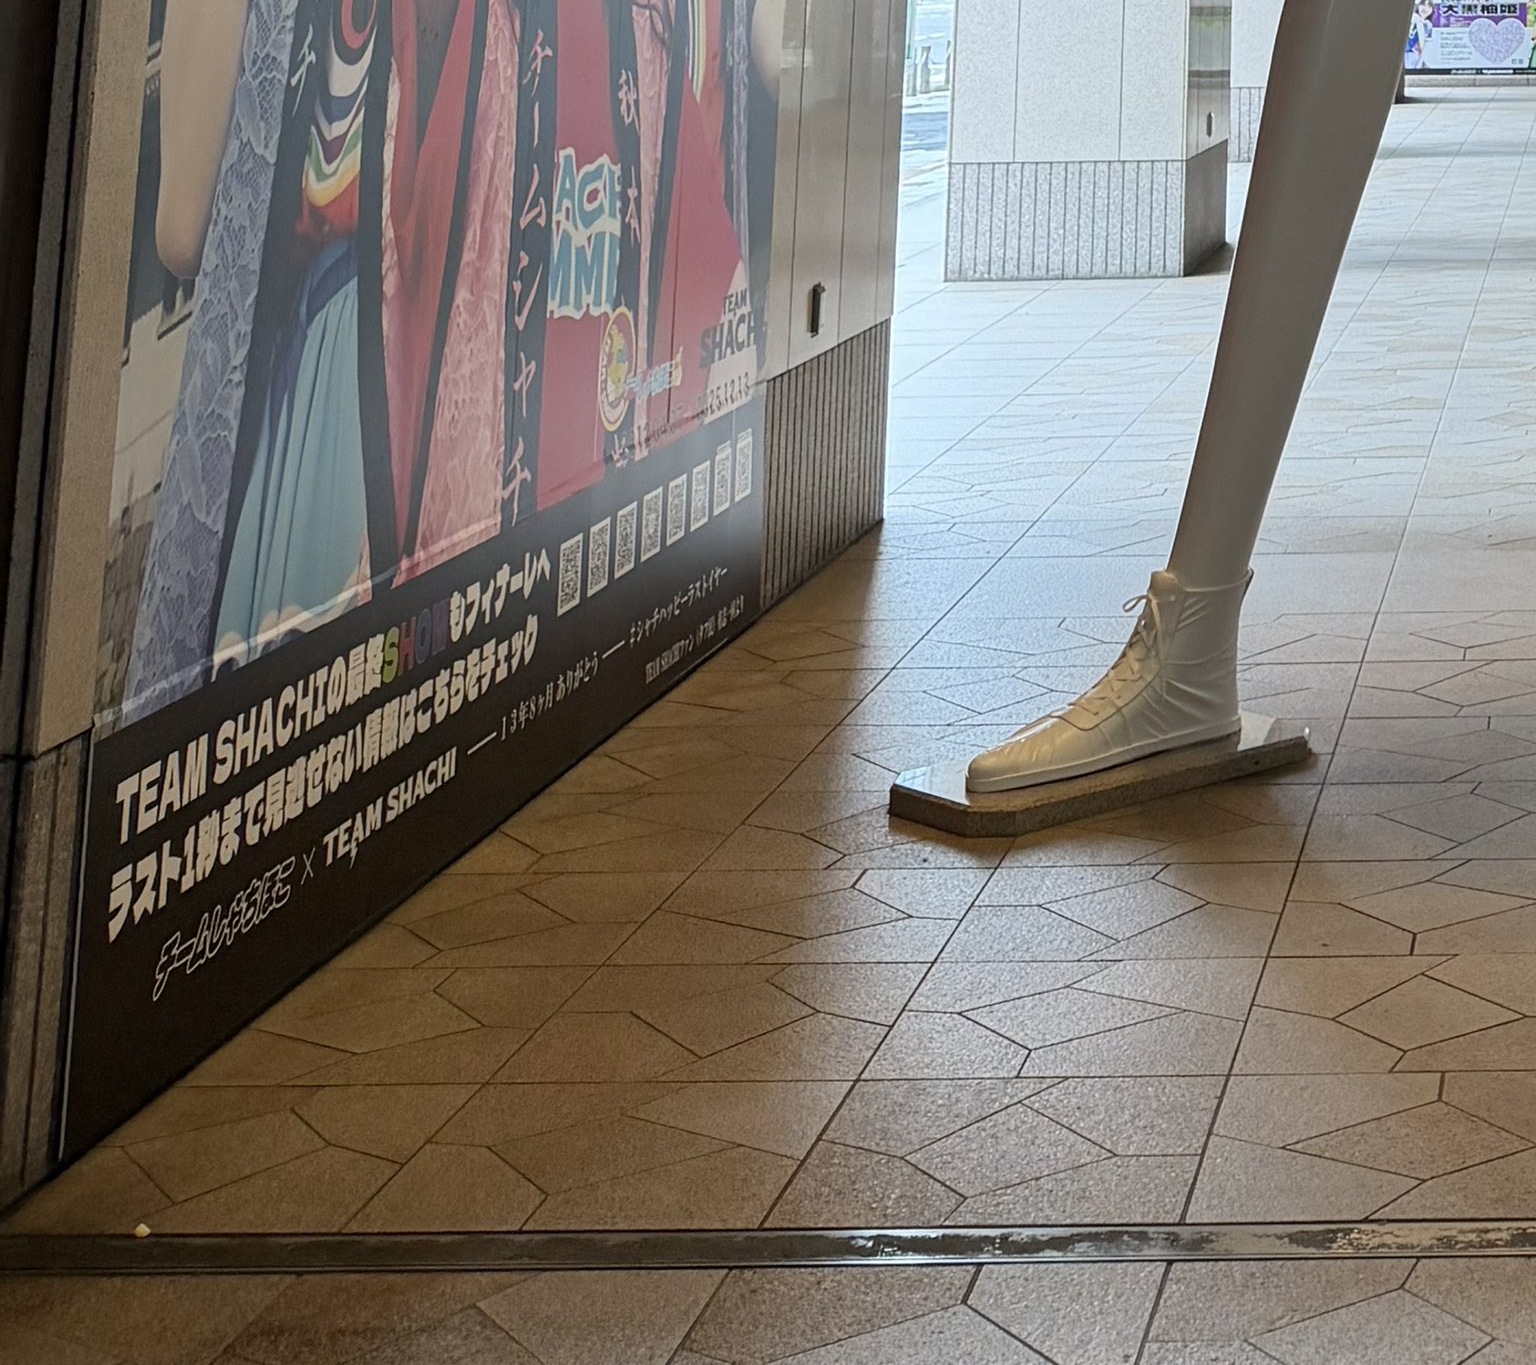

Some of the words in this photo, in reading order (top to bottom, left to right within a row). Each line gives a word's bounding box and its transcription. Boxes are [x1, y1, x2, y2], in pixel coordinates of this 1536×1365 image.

[499, 28, 554, 528] チームシャチ
[107, 614, 539, 944] ラスト1秒まで見逃せない情報はこちらをチェック
[116, 733, 209, 845] TEAM
[322, 797, 383, 869] TEAM
[386, 746, 458, 824] SHACHI
[556, 651, 600, 702] ありがとう
